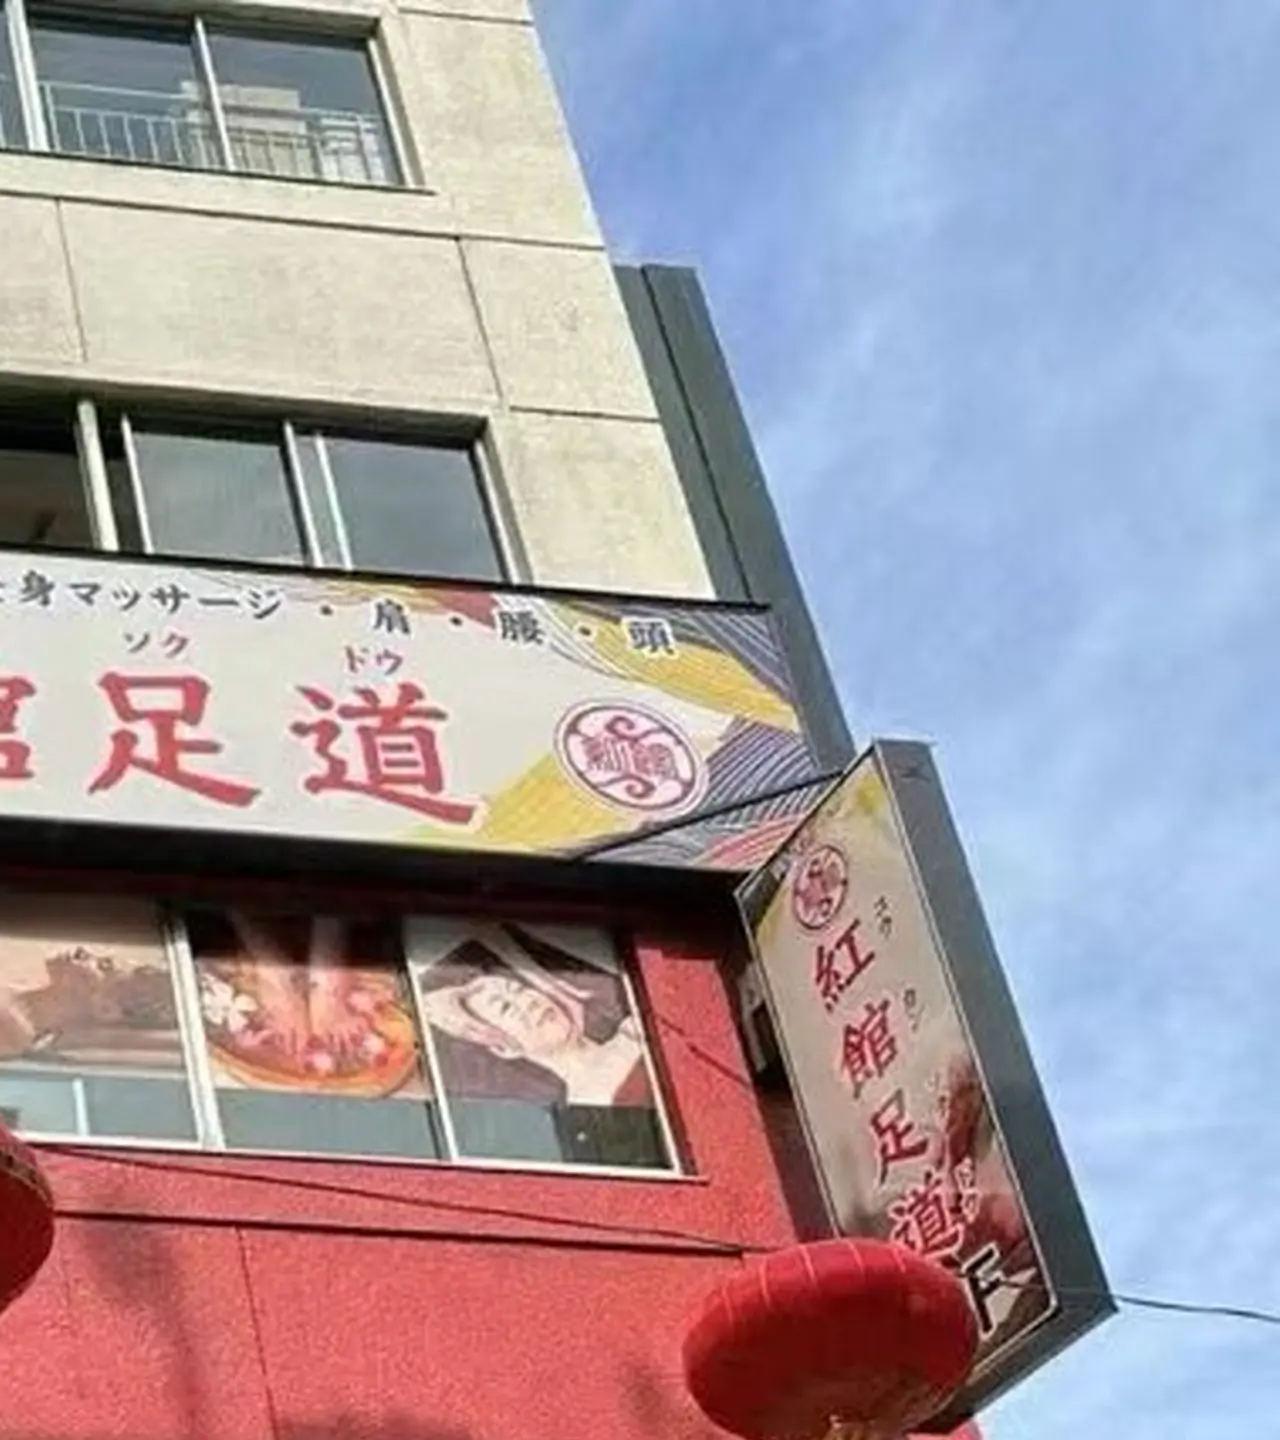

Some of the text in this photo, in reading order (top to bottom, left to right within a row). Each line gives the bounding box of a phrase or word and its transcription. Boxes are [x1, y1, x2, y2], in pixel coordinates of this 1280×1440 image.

[124, 629, 190, 659] ソク
[344, 645, 404, 677] ドウ
[814, 916, 964, 1259] 紅館足道
